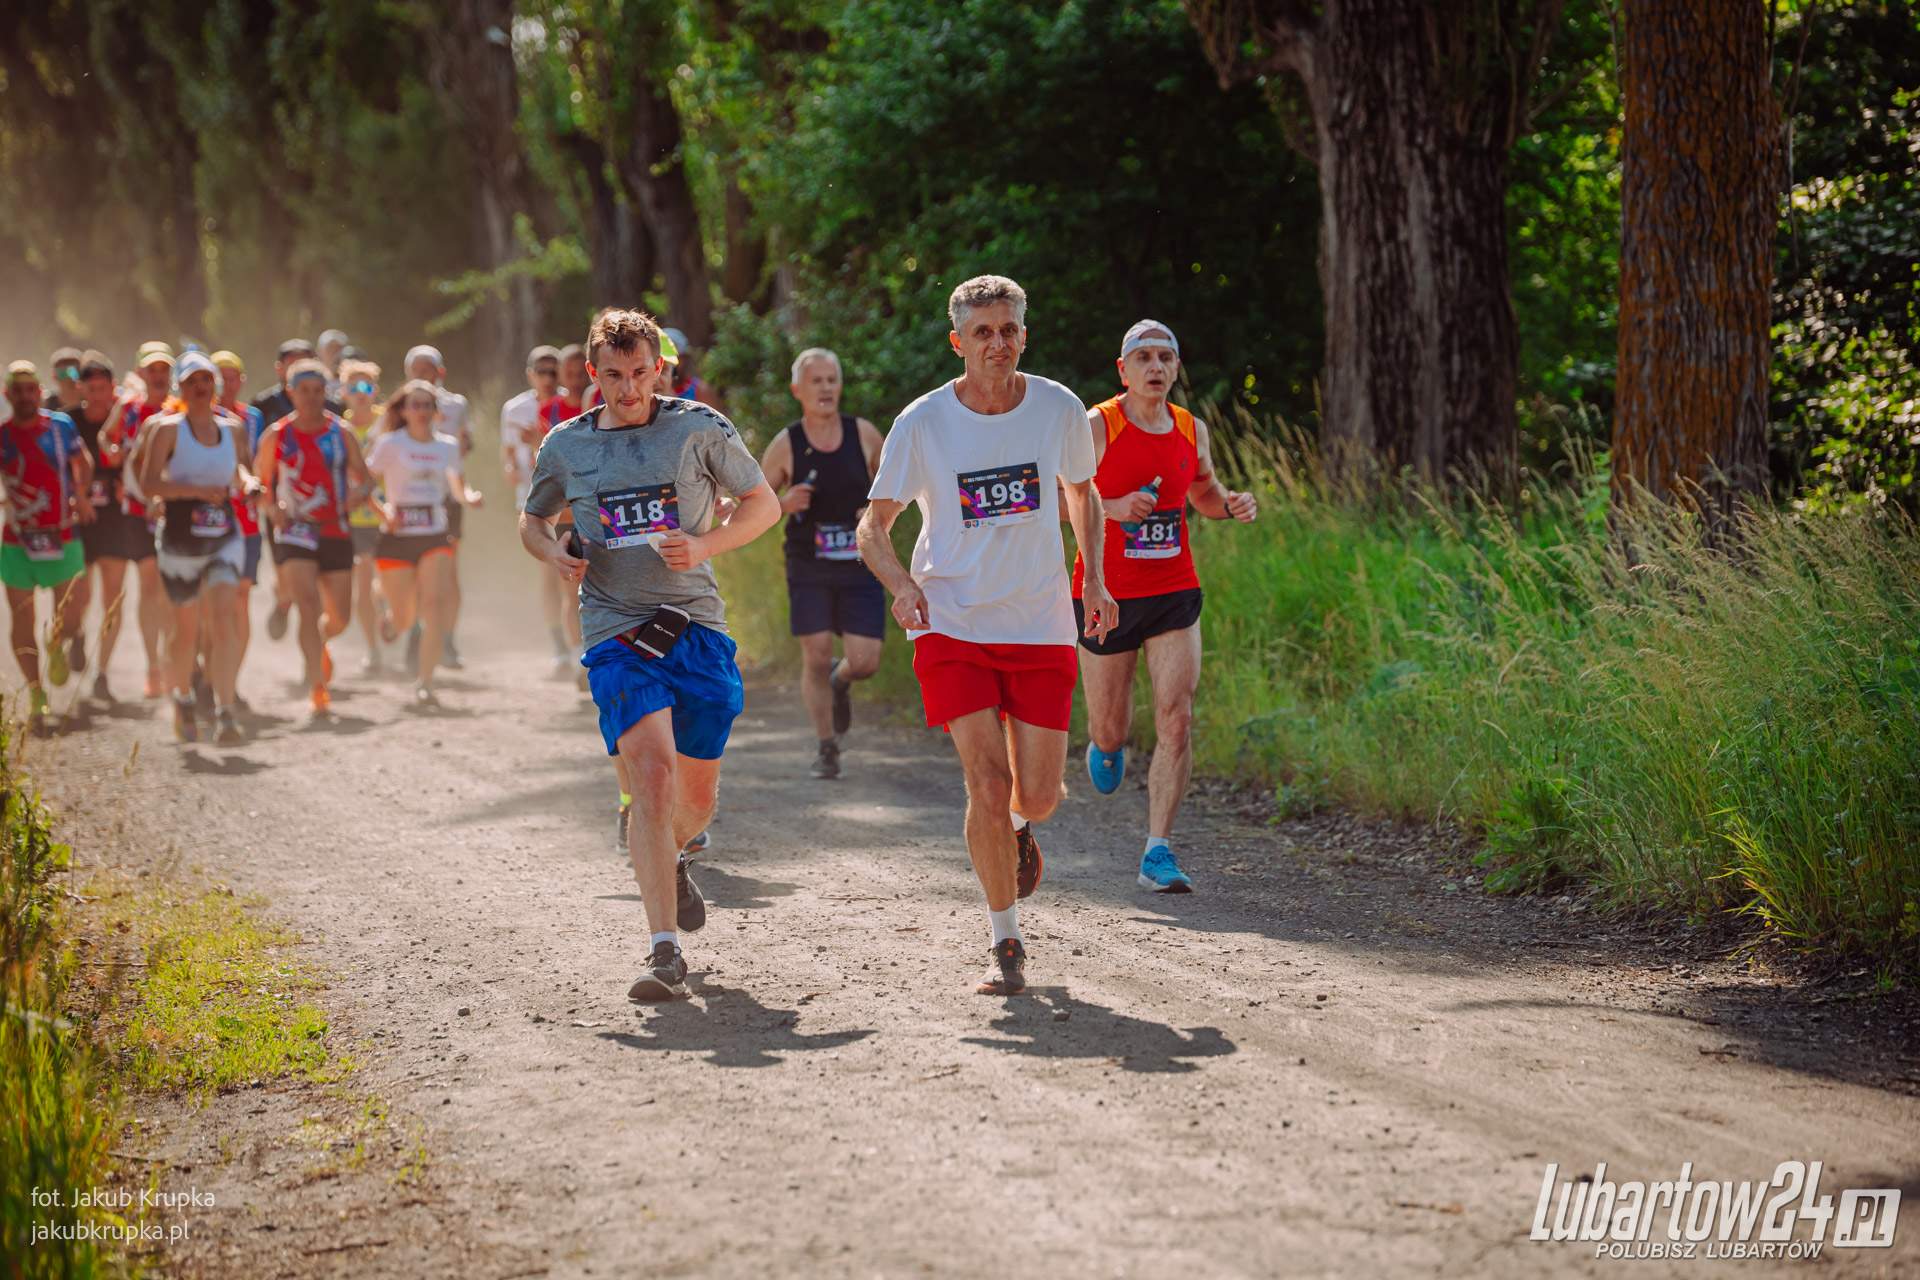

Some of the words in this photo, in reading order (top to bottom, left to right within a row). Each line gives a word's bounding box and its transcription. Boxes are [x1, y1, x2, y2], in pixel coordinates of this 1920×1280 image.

[975, 480, 1026, 508] 198
[614, 499, 665, 527] 118
[825, 530, 857, 547] 187
[1138, 523, 1176, 542] 181
